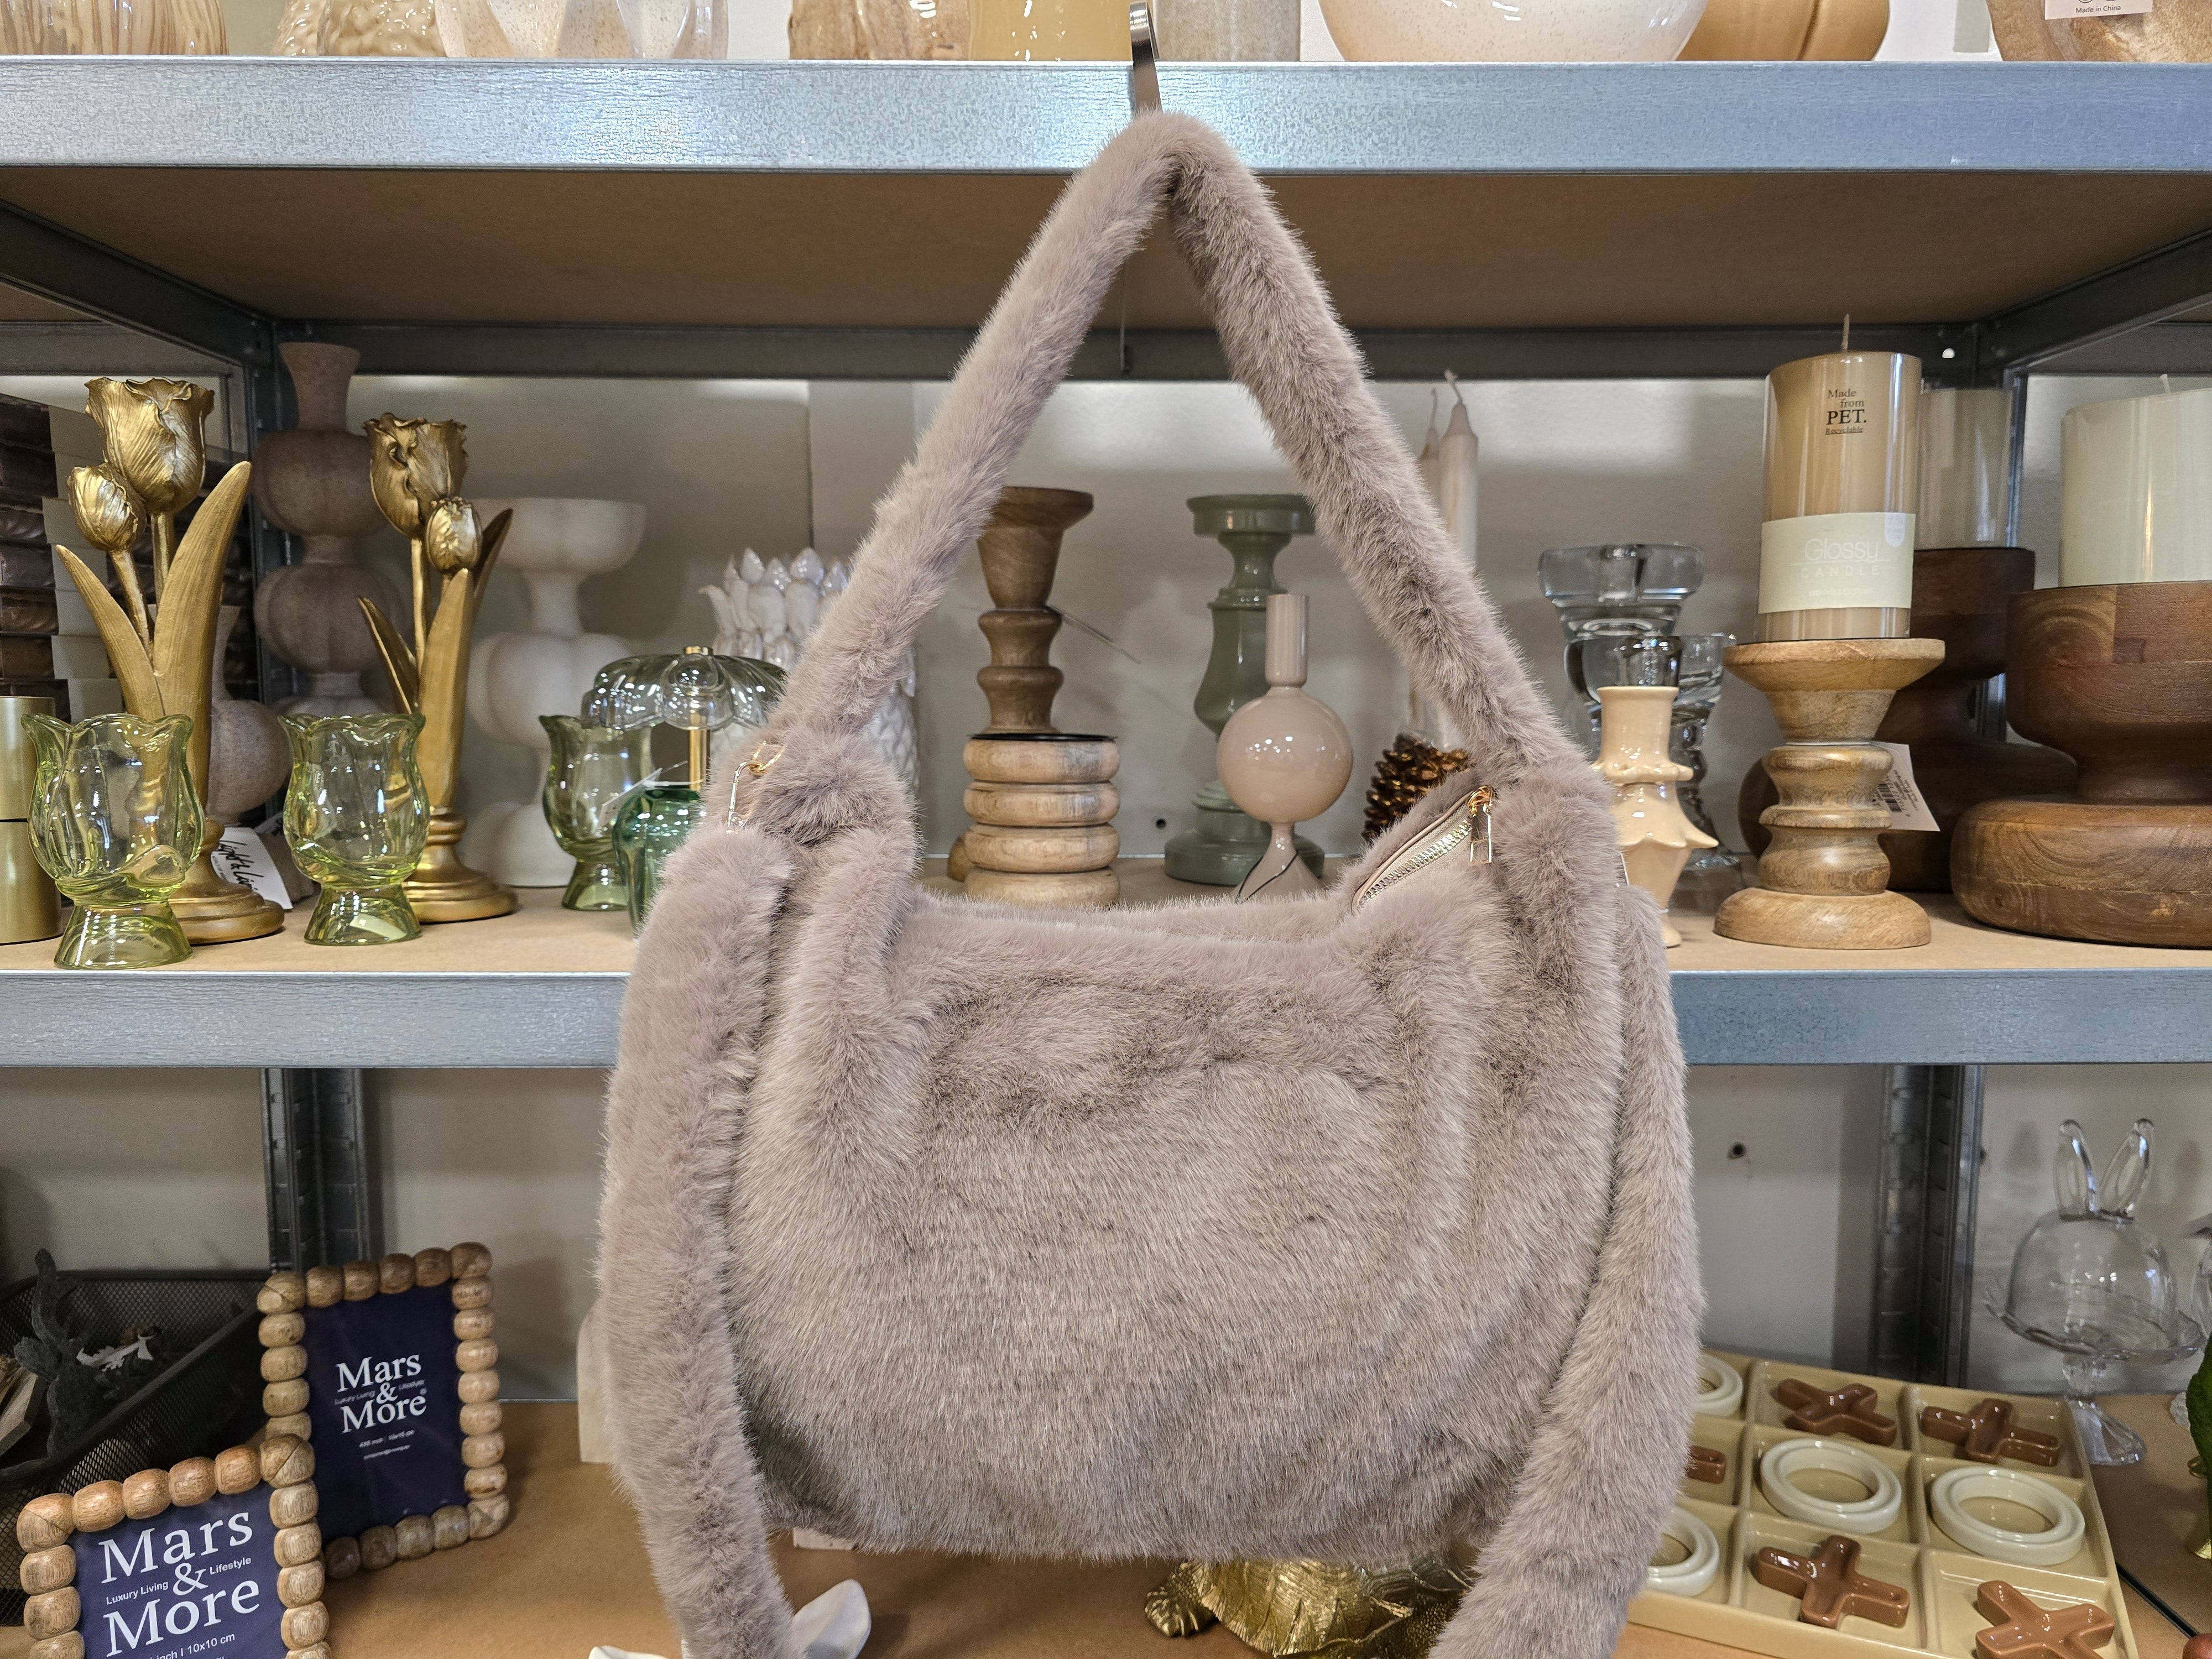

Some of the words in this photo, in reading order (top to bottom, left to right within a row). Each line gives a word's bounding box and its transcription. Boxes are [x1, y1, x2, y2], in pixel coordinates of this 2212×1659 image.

[1827, 388, 1856, 398] Made
[1840, 399, 1864, 408] from
[1825, 409, 1866, 425] PET.
[1805, 538, 1879, 563] Glossy
[1801, 566, 1880, 578] CANDLE
[336, 1354, 421, 1392] Mars
[375, 1382, 398, 1404] &
[340, 1395, 427, 1434] More
[98, 1511, 253, 1584] Mars
[210, 1557, 252, 1575] Lifestyle
[173, 1563, 208, 1595] &
[106, 1590, 138, 1605] Luxury
[140, 1581, 168, 1595] Living
[103, 1580, 260, 1657] More
[187, 1637, 217, 1654] 10x10
[220, 1634, 235, 1644] cm
